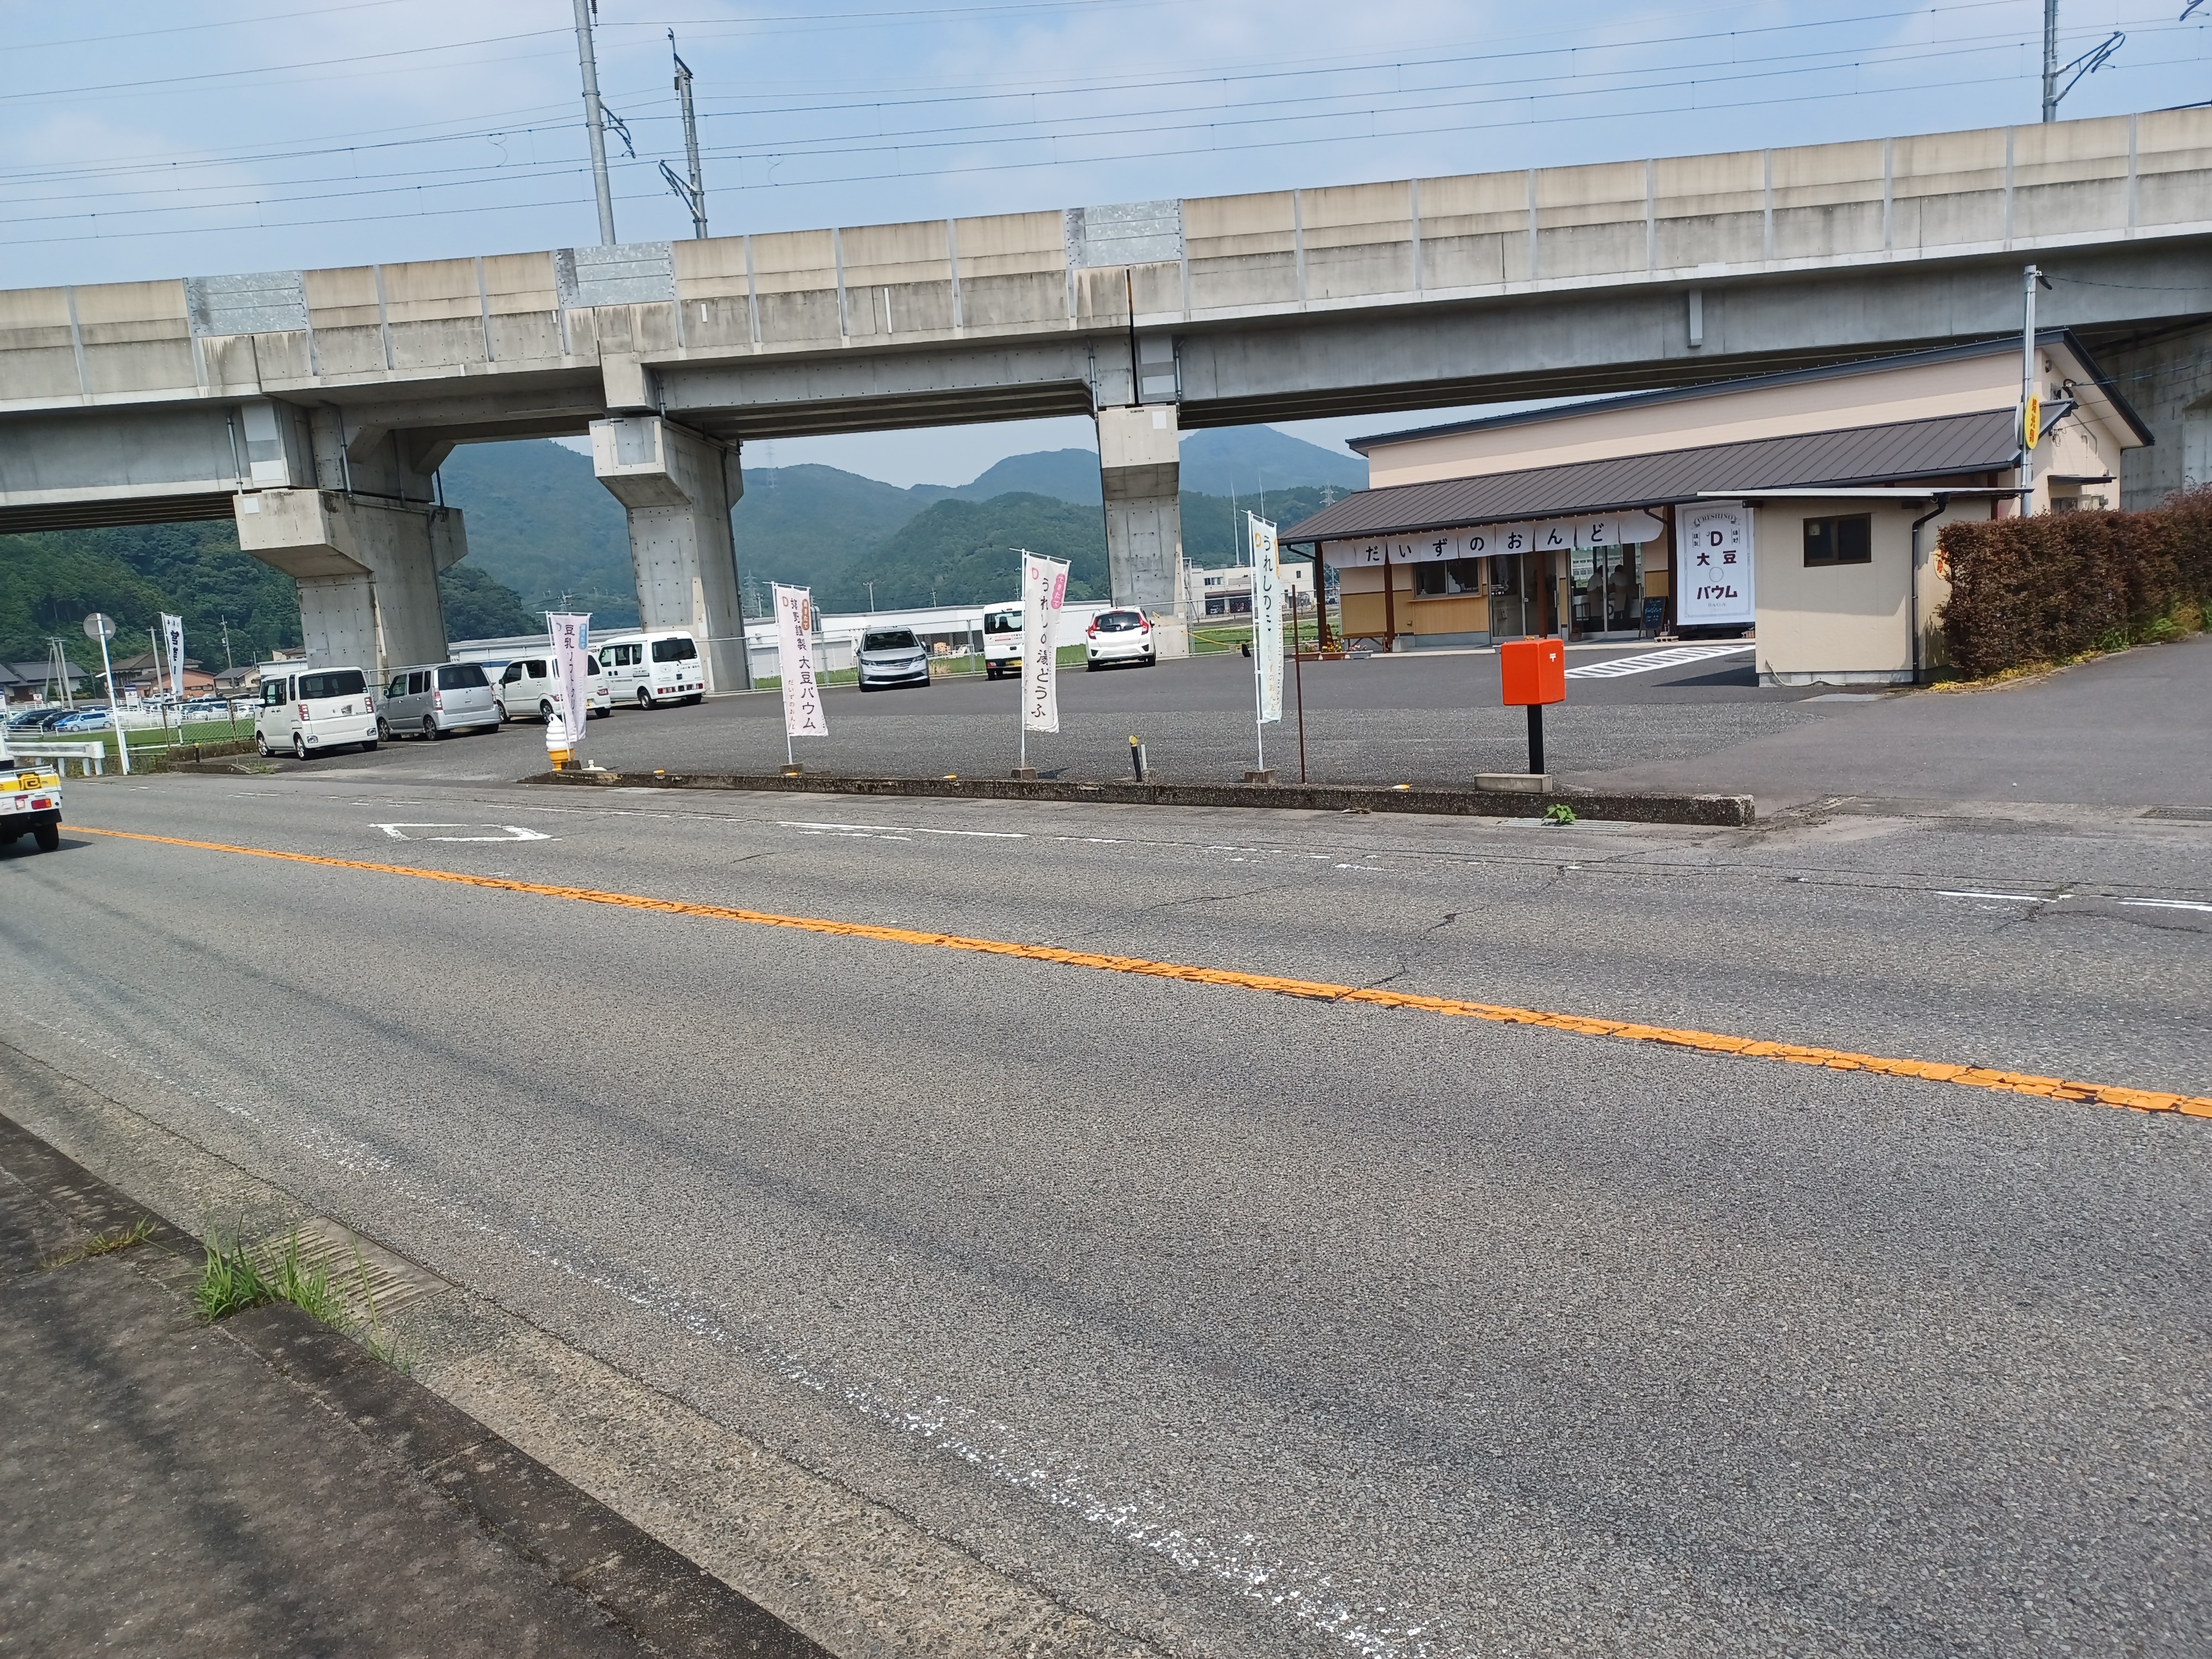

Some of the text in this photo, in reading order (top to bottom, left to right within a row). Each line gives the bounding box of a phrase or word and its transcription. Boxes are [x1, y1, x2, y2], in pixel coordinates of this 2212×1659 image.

[1365, 523, 1604, 562] だいずのおんど
[1710, 531, 1723, 546] D
[1697, 550, 1736, 566] 大豆
[1697, 586, 1738, 599] バウム
[564, 624, 576, 715] 豆乳ソフトクリ
[799, 656, 816, 729] 大豆バウム
[18, 773, 41, 790] 危
